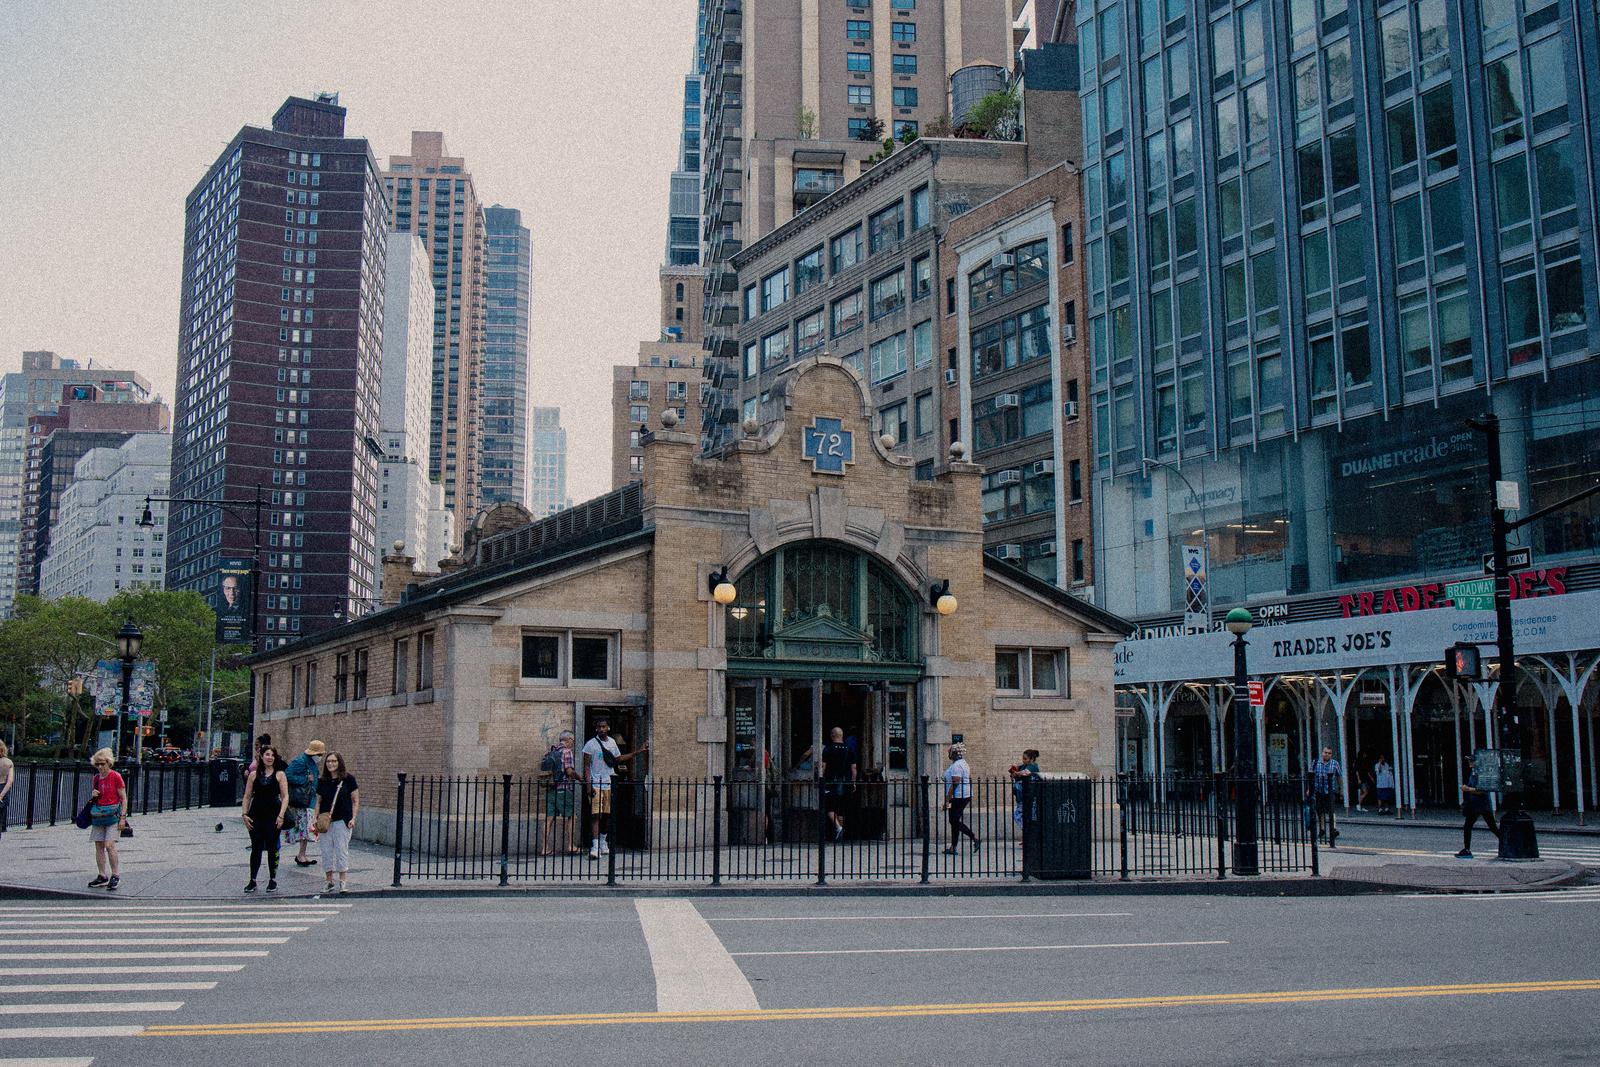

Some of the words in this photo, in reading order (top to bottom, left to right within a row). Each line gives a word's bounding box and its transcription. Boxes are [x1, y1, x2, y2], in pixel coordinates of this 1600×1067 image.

[813, 432, 844, 457] 72
[1450, 431, 1473, 443] OPEN
[1341, 452, 1392, 477] DUANE
[1393, 436, 1448, 466] reade
[1510, 555, 1525, 564] WAY
[1447, 582, 1494, 598] BROADWAY
[1337, 583, 1452, 619] TRADE
[1457, 598, 1466, 609] W
[1470, 597, 1483, 609] 72
[1259, 604, 1288, 618] OPEN
[1452, 622, 1497, 631] Condomini
[1514, 615, 1557, 625] esidences
[1273, 636, 1337, 657] TRADER
[1342, 630, 1392, 651] JOE'S
